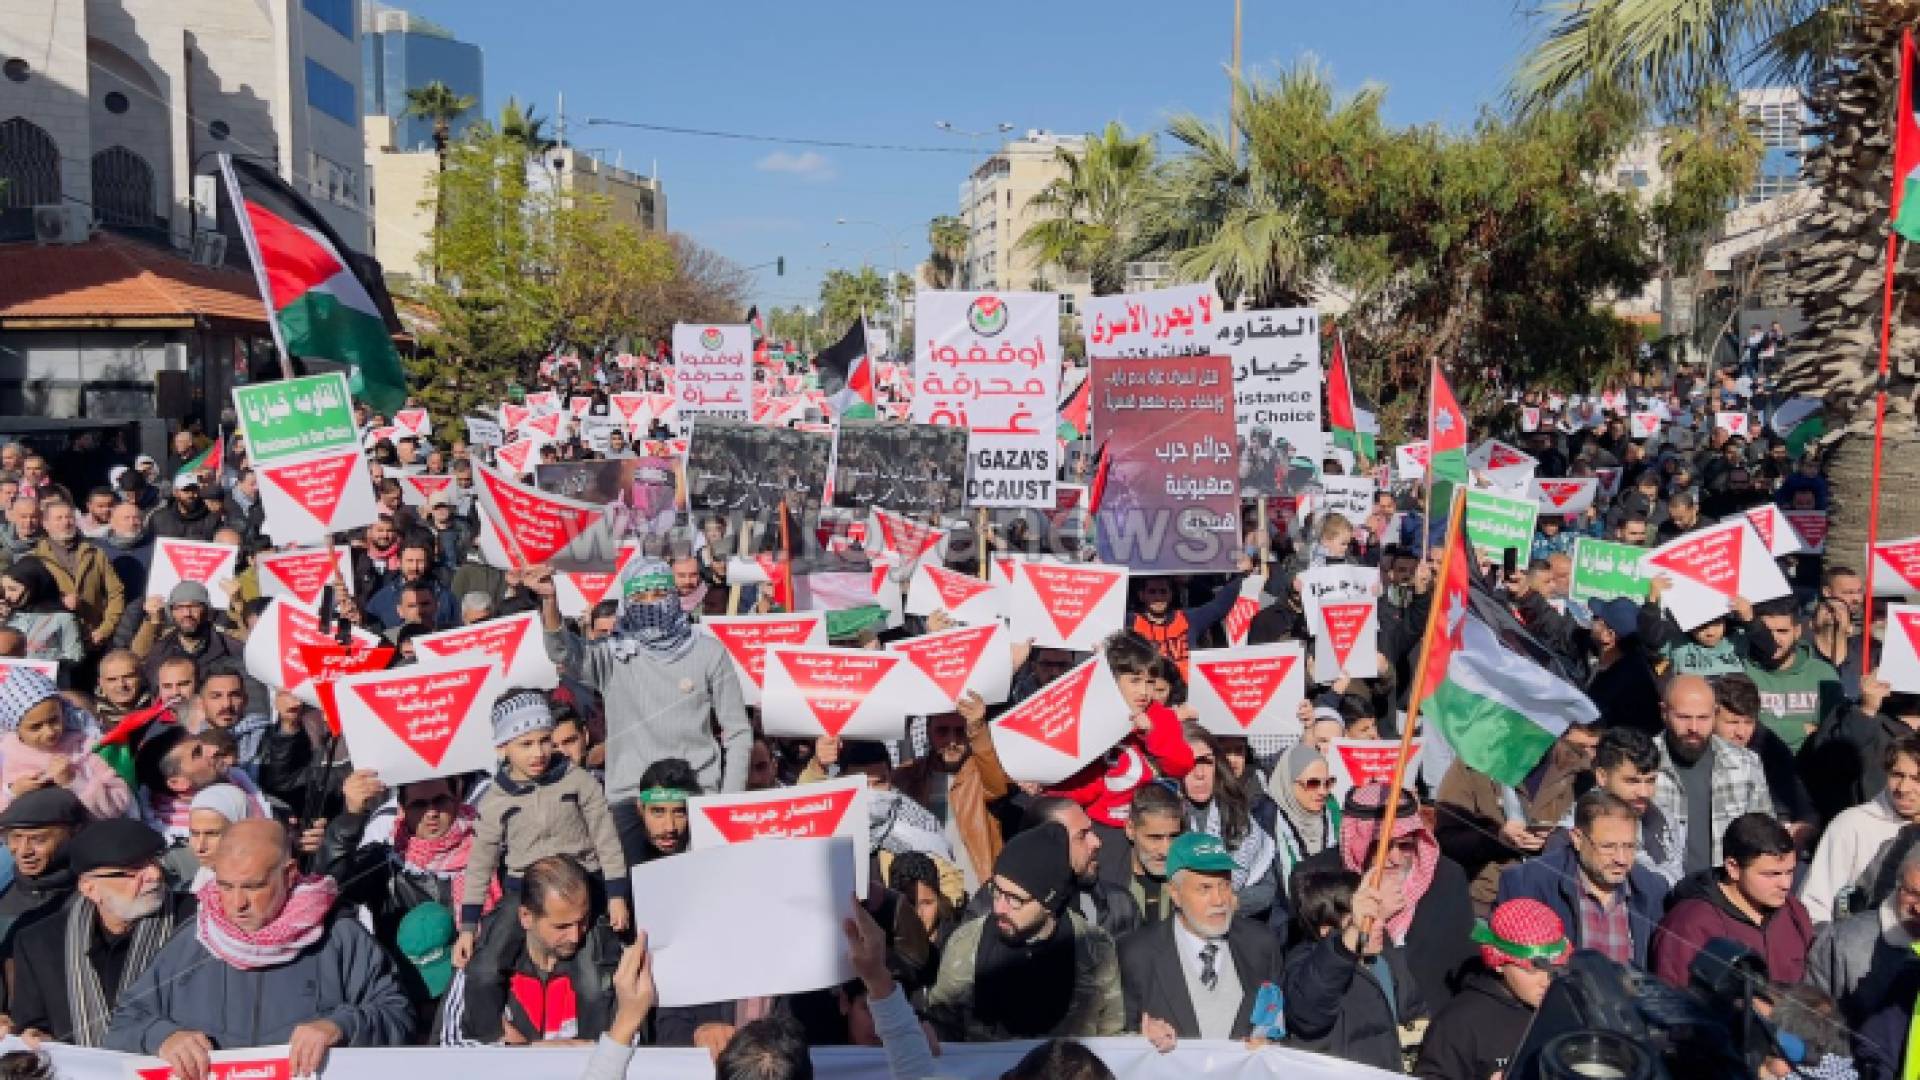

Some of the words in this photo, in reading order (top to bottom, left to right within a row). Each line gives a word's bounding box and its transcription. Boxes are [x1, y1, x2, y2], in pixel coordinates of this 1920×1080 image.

[1199, 294, 1212, 324] لا
[1152, 304, 1194, 338] يحرر
[683, 383, 743, 406] غزة
[922, 372, 1046, 400] محرقة
[1233, 389, 1313, 406] istance
[1255, 410, 1316, 425] Choice
[978, 449, 1050, 472] GAZA'S
[1155, 441, 1189, 464] حرب
[1165, 474, 1235, 501] صهيونية
